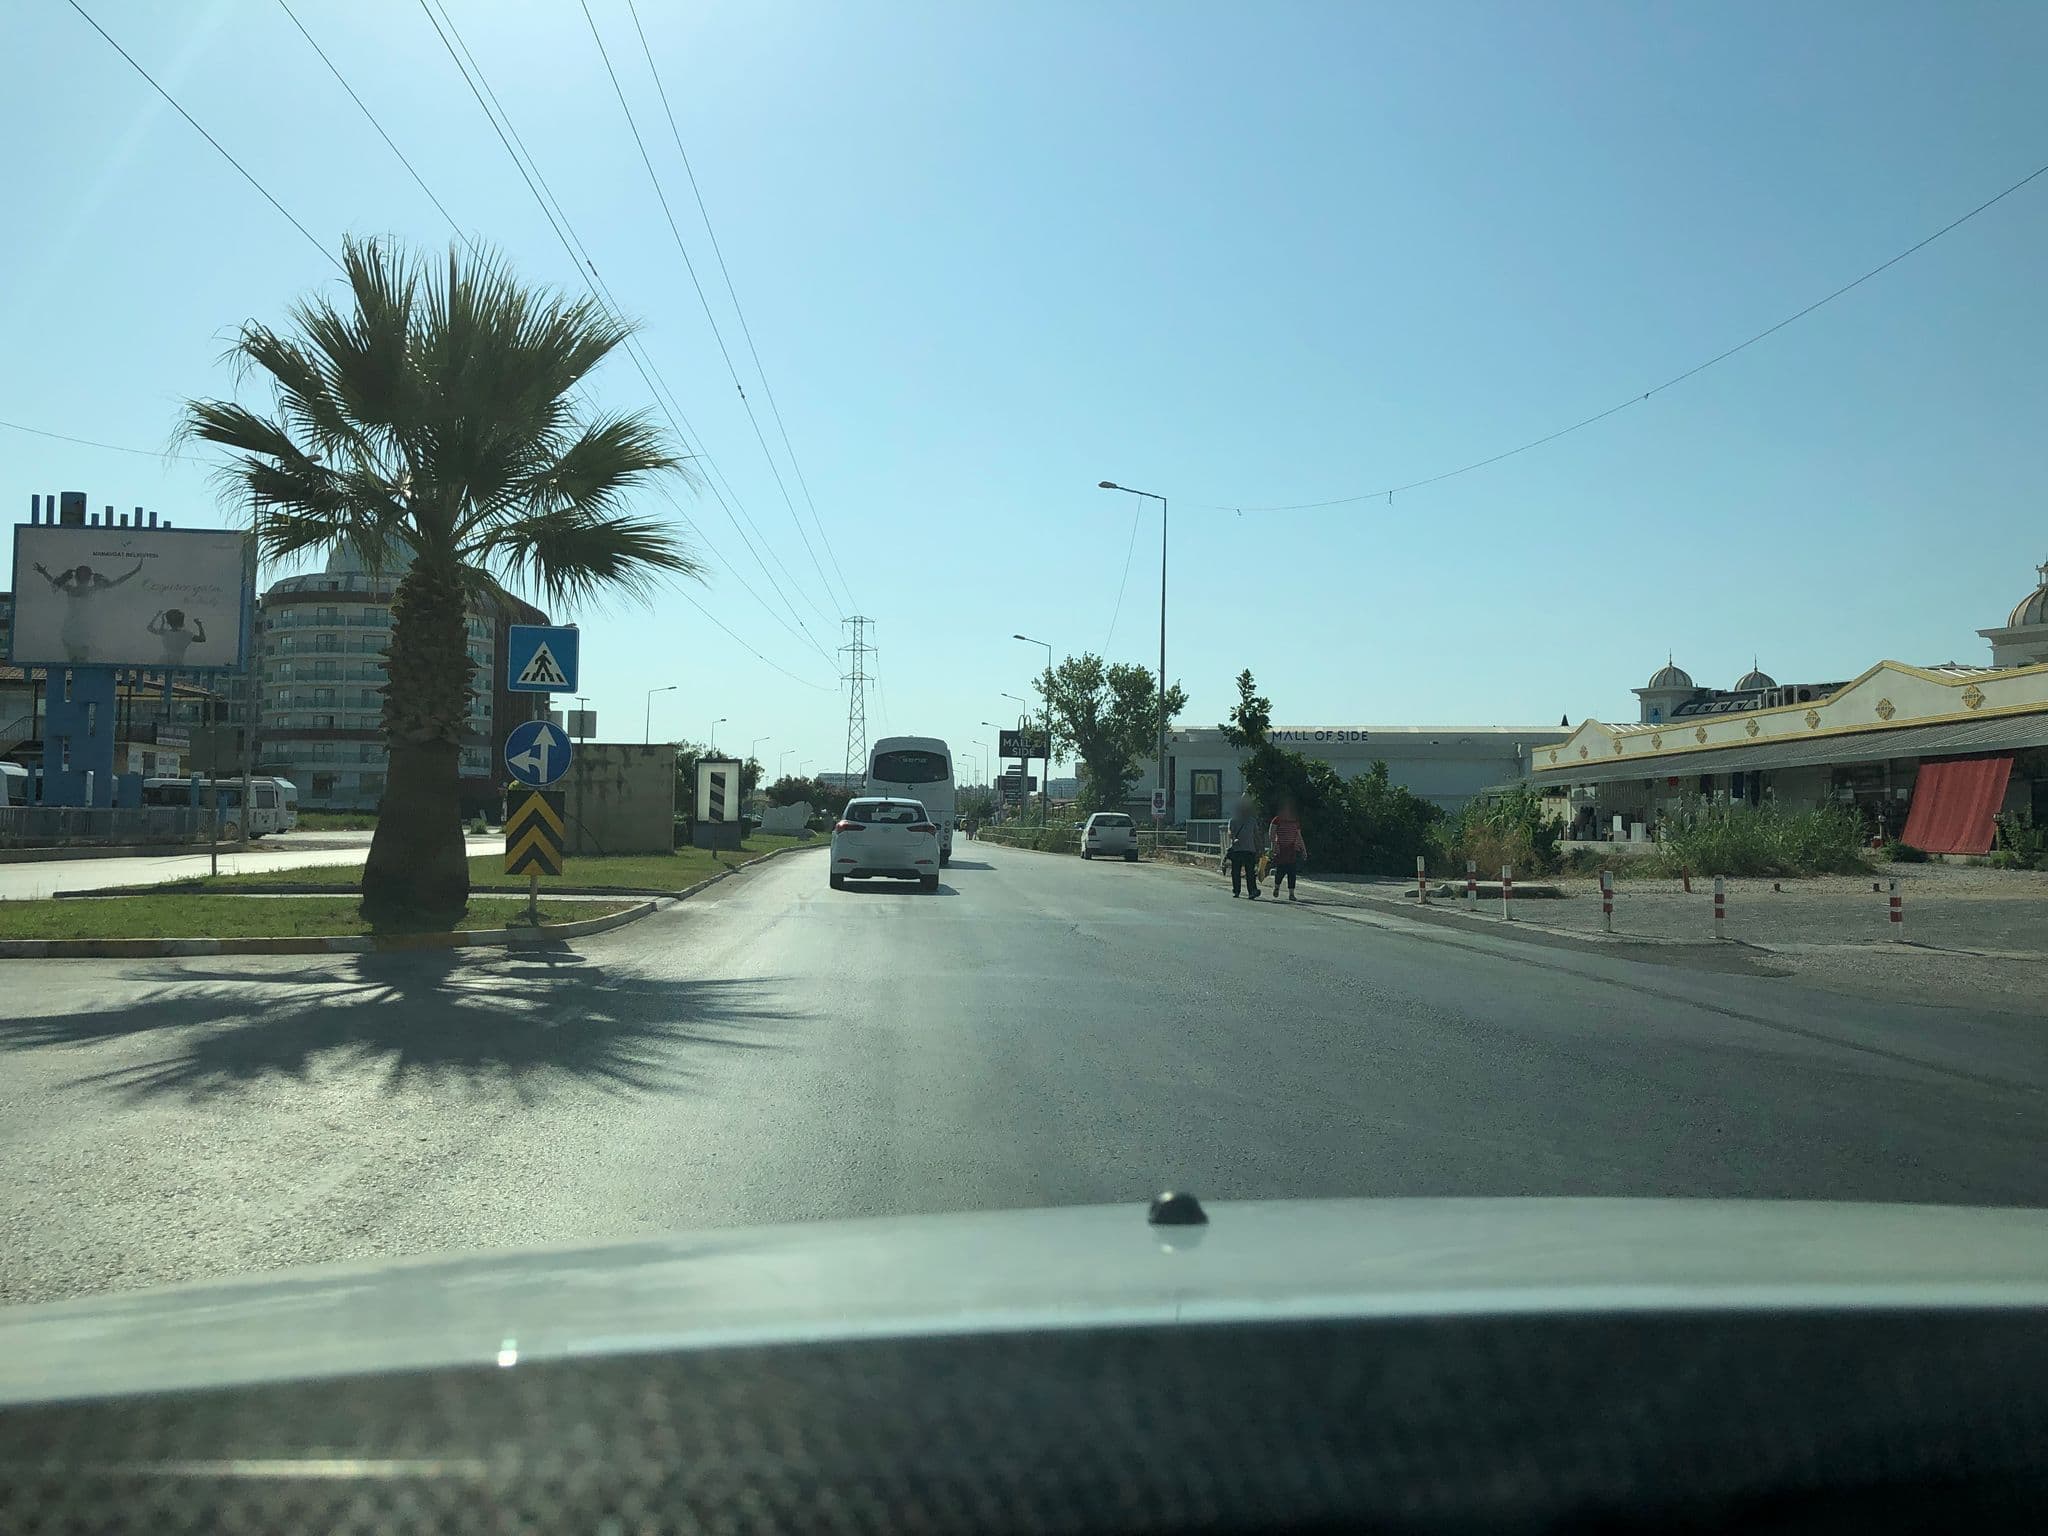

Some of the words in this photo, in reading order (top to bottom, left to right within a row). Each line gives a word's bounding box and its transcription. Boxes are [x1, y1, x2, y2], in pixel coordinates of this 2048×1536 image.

[1272, 731, 1308, 741] MALL
[1314, 731, 1333, 741] OF
[1337, 731, 1368, 741] SIDE
[1003, 738, 1031, 747] MALL
[1012, 747, 1035, 756] SIDE
